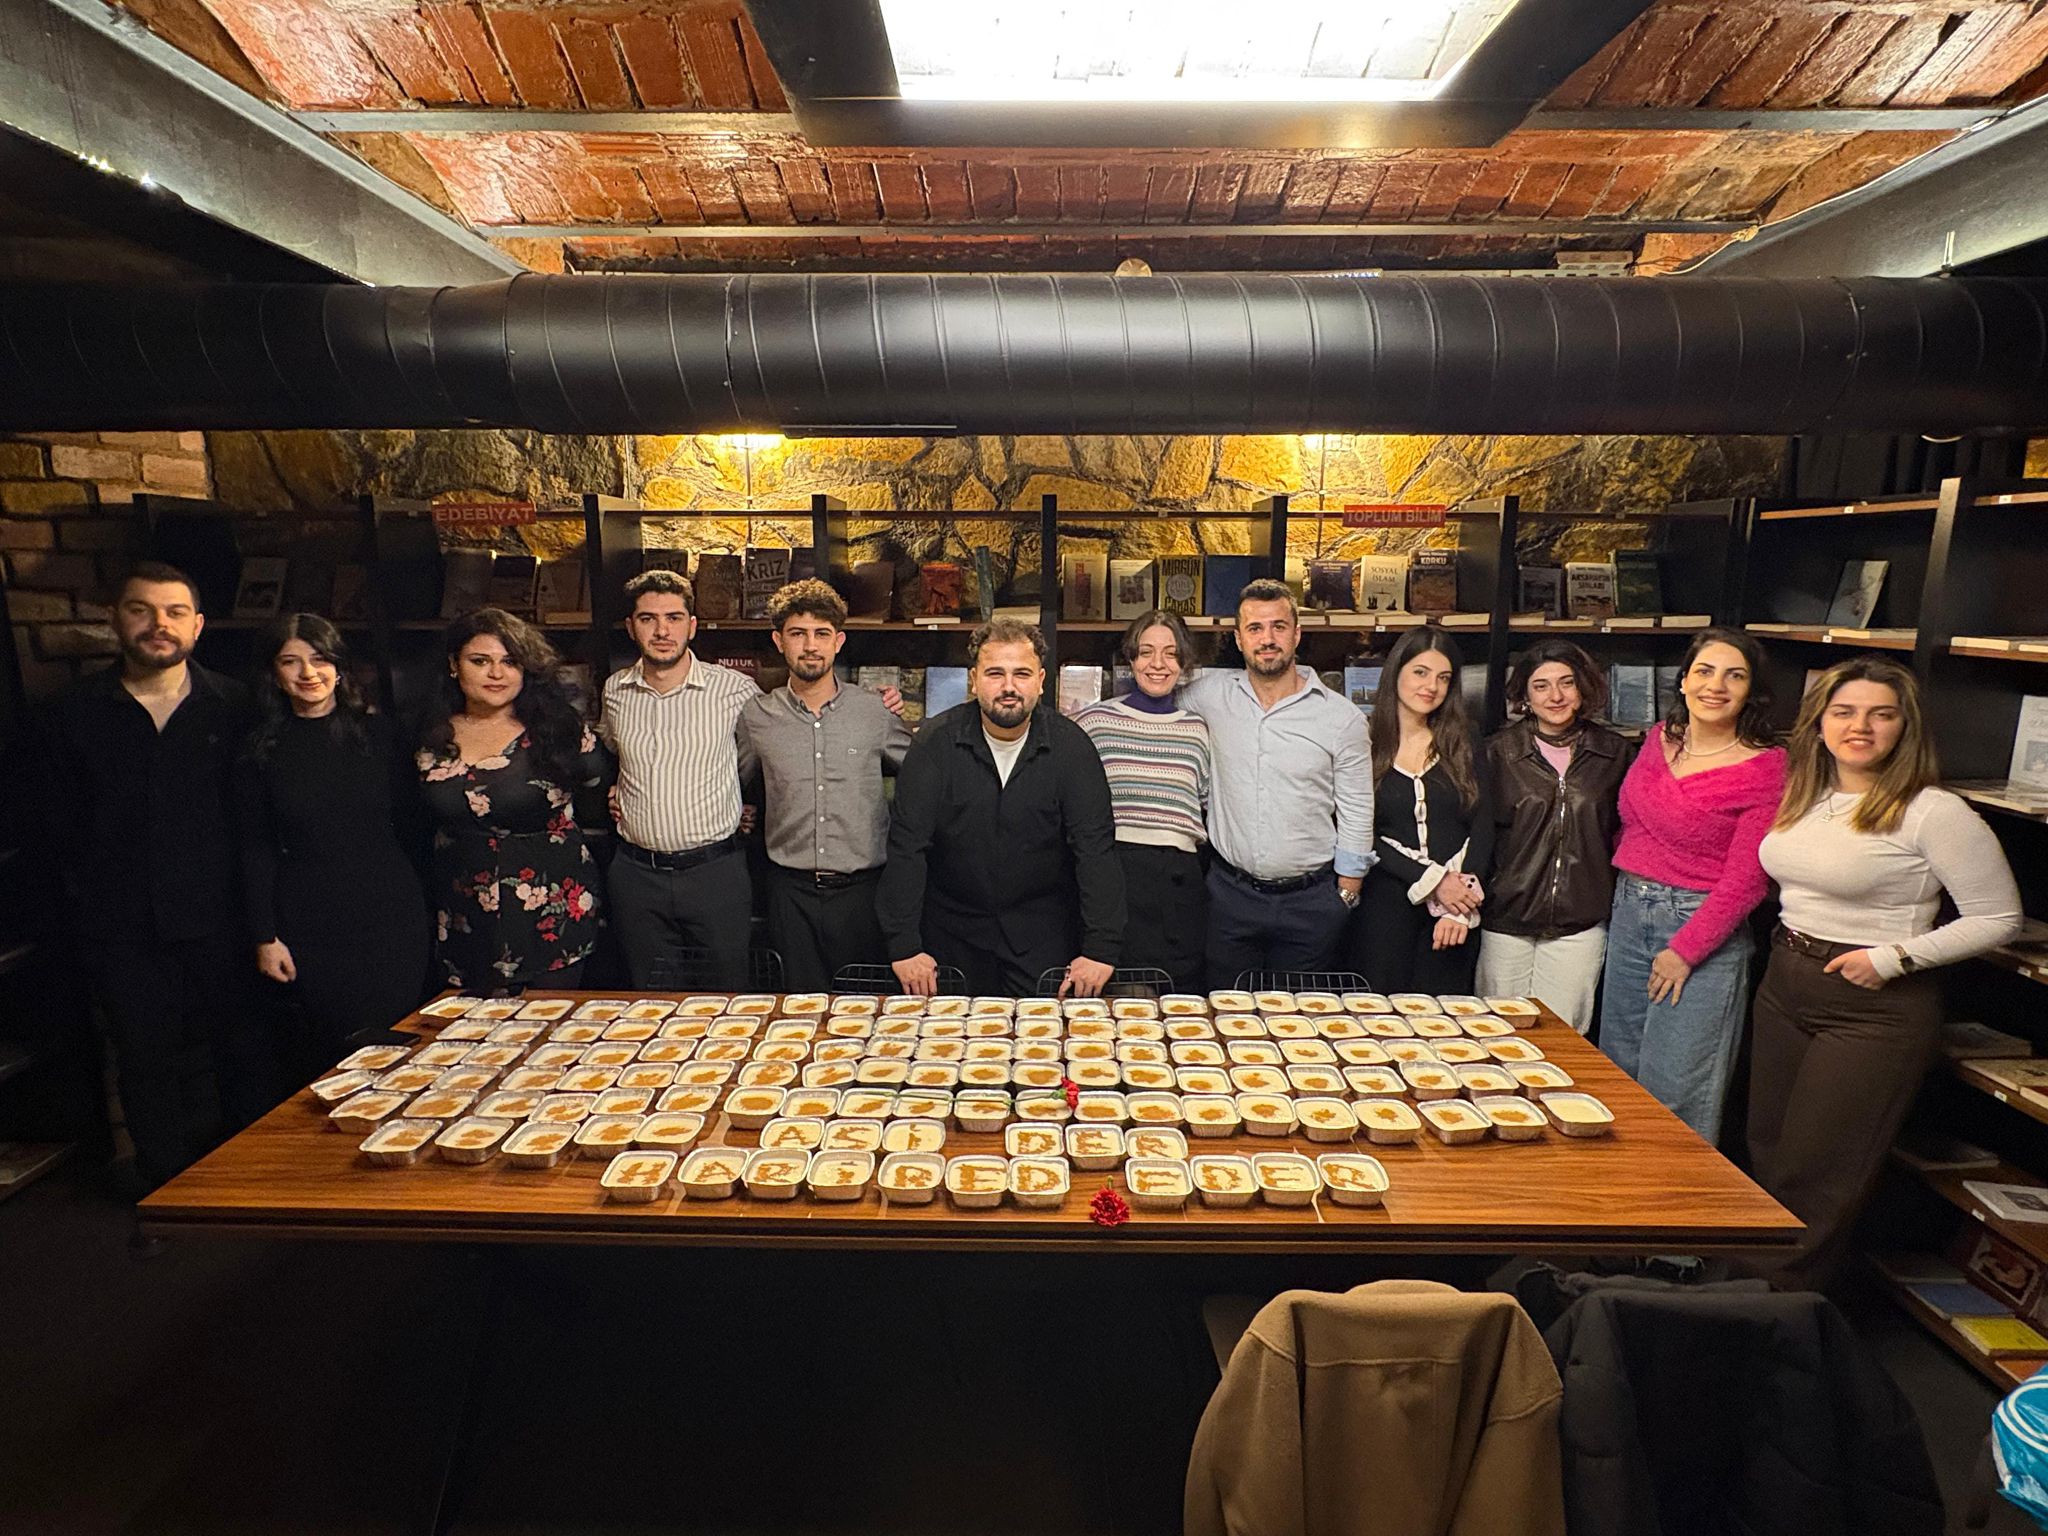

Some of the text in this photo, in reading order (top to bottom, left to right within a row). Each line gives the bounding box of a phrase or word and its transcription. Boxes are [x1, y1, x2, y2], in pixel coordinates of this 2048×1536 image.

[435, 505, 533, 521] EDEBİYAT
[1346, 507, 1442, 523] TOPLUM BİLİM
